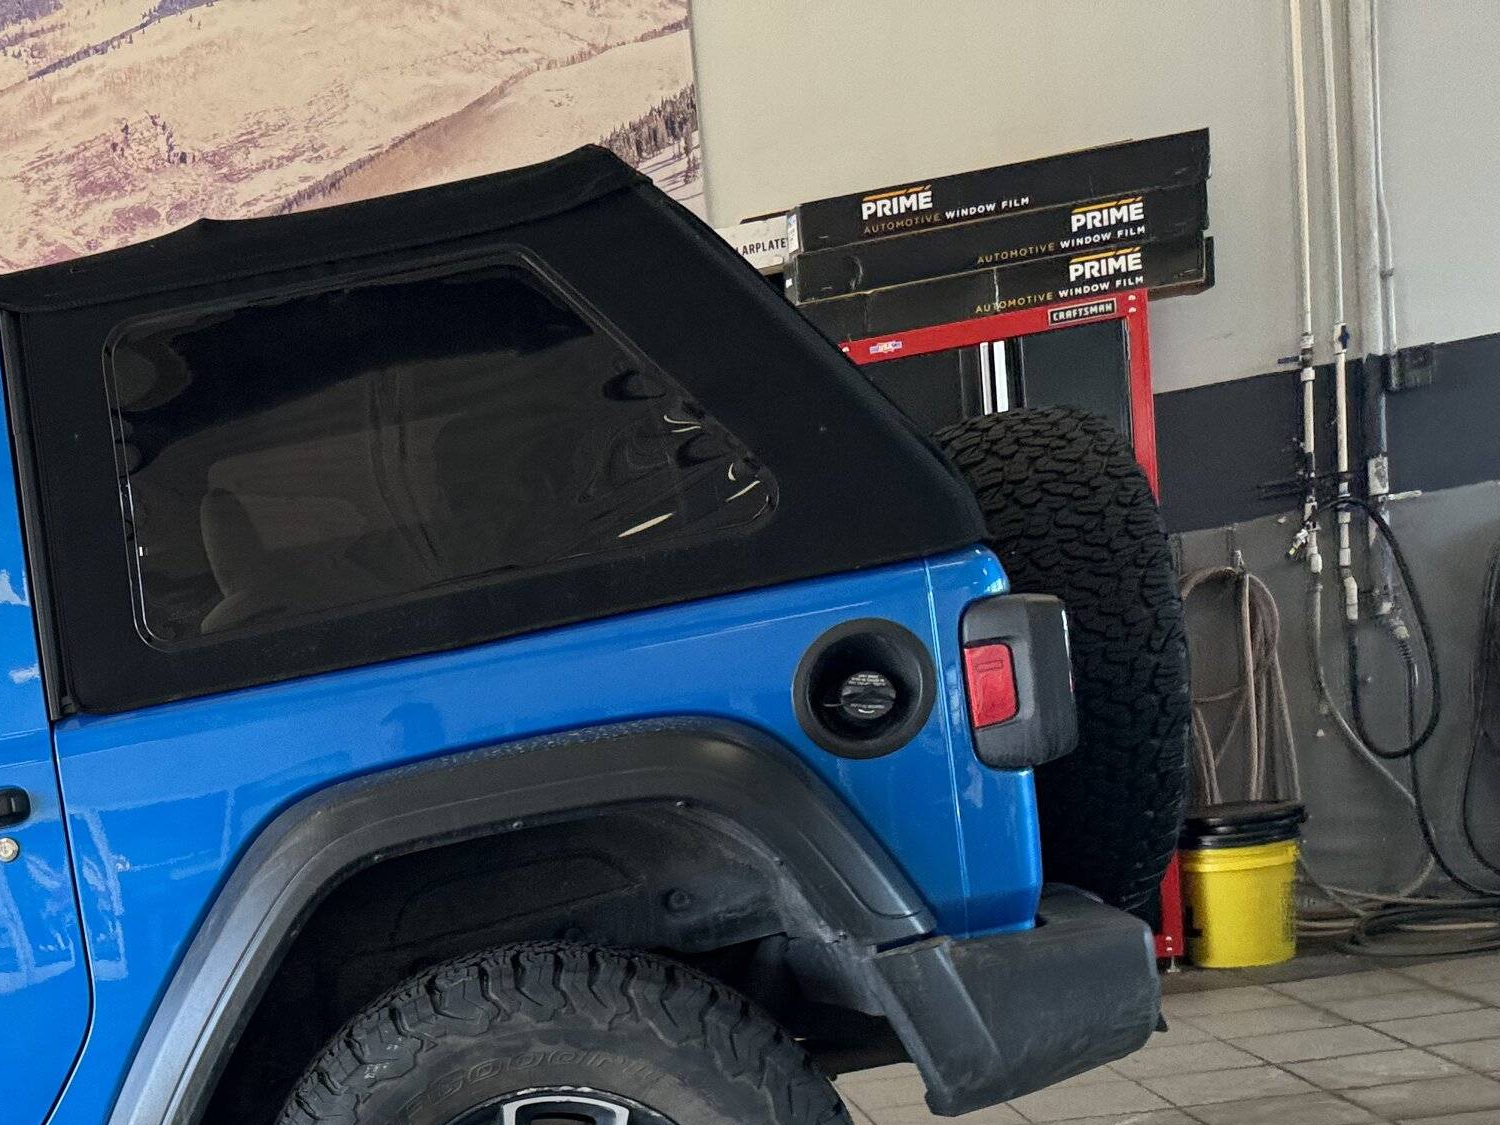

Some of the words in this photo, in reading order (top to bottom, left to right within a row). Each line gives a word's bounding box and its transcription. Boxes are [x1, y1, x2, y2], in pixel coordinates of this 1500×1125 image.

[861, 190, 933, 221] PRIME
[863, 213, 941, 235] AUTOMOTIVE
[945, 202, 997, 220] WINDOW
[1001, 196, 1030, 210] FILM
[1070, 202, 1145, 233] PRIME
[736, 237, 787, 256] ARPLATE
[977, 242, 1055, 265] AUTOMOTIVE
[1060, 232, 1112, 249] WINDOW
[1117, 225, 1146, 238] FILM
[1068, 252, 1143, 282] PRIME
[975, 291, 1053, 314] AUTOMOTIVE
[1058, 281, 1111, 298] WINDOW
[1115, 275, 1144, 289] FILM
[1052, 303, 1113, 321] CRAFTSMAN
